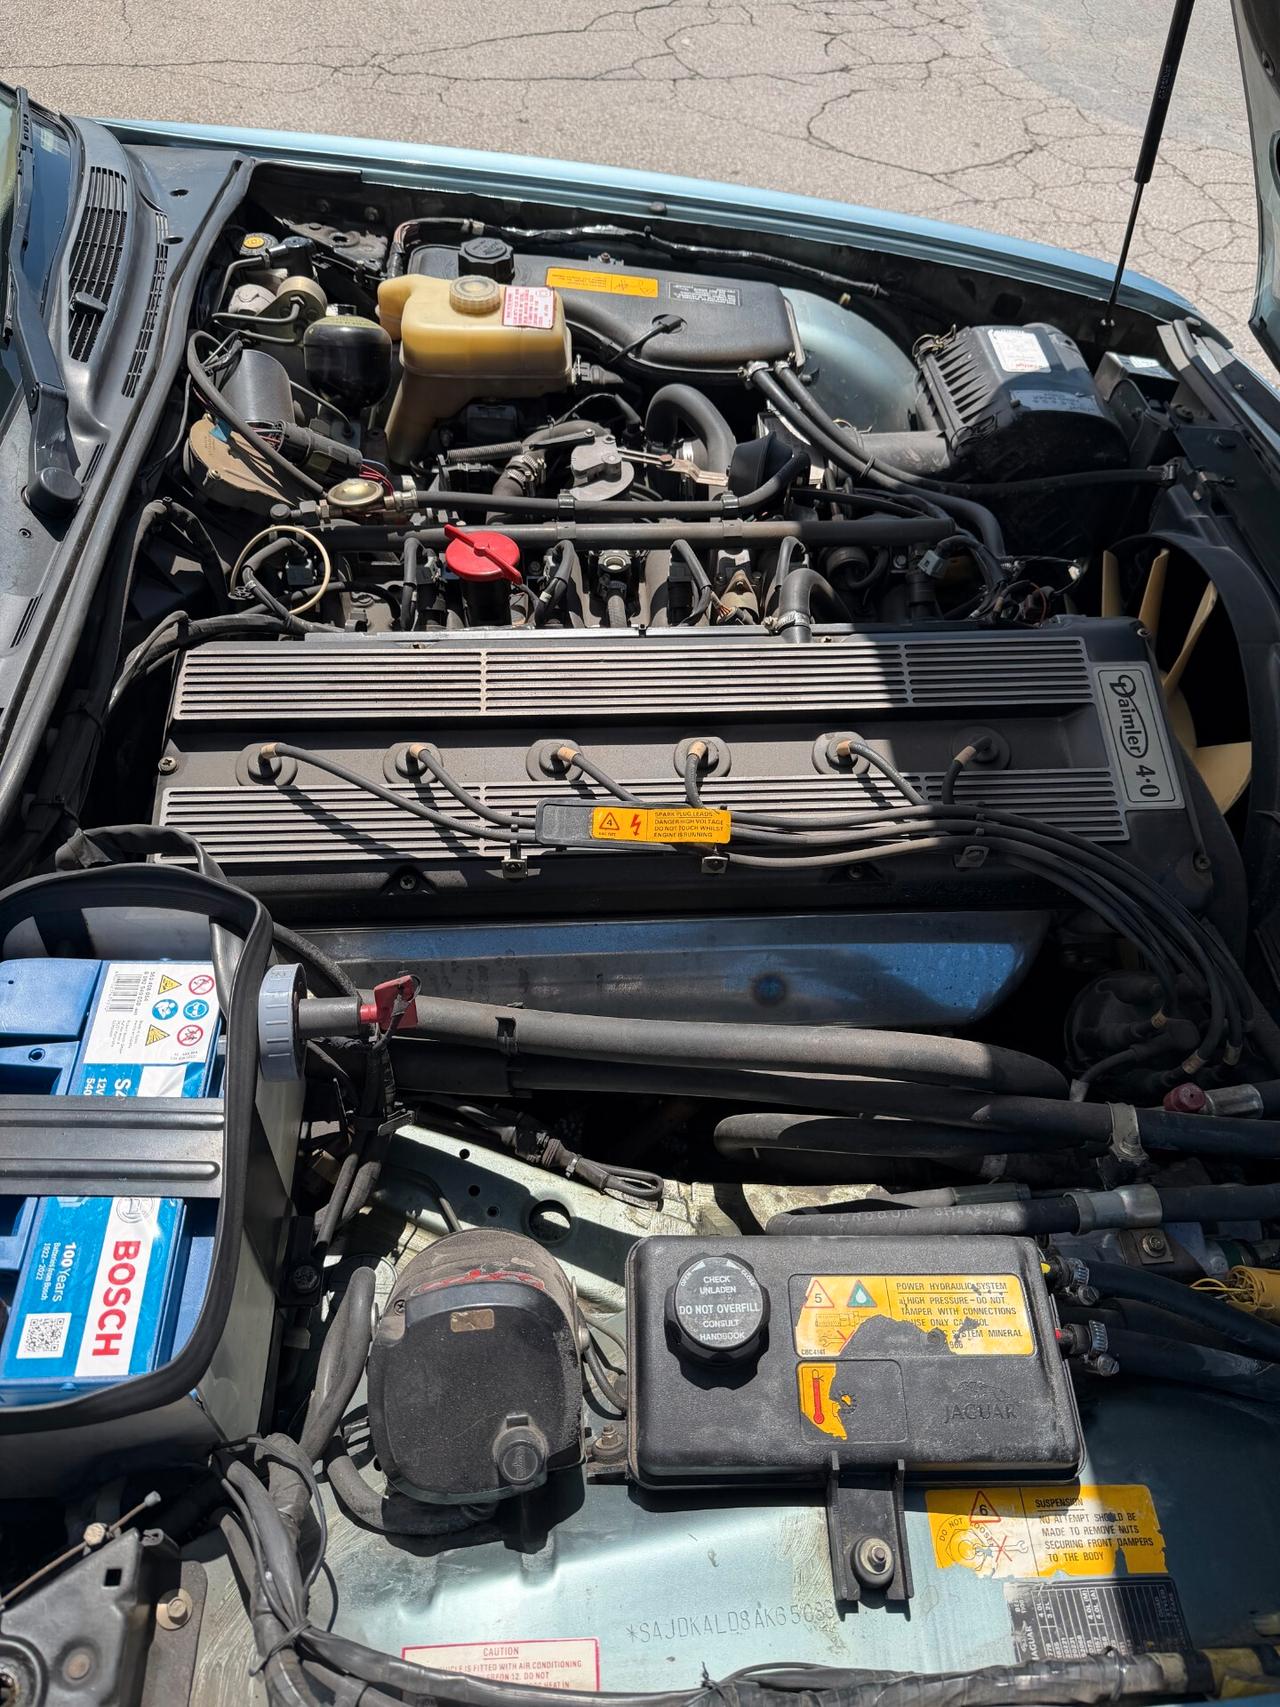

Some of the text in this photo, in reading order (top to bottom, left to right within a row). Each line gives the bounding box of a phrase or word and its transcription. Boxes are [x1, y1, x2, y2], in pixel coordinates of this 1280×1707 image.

[1109, 674, 1148, 758] Daimler
[84, 1077, 95, 1096] 540
[96, 1077, 107, 1096] 12V
[41, 1242, 61, 1301] Batteries from Bosch
[681, 1269, 757, 1289] OPEN CLOSE
[703, 1275, 731, 1284] CHECK
[699, 1286, 736, 1295] UNLADEN
[896, 1282, 1007, 1290] POWER HYDRAULIC SYSTEM
[92, 1240, 141, 1356] BOSCH
[814, 1293, 822, 1303] 5
[930, 1296, 968, 1304] PRESSURE
[976, 1296, 987, 1304] DO
[990, 1296, 1005, 1304] NOT
[679, 1302, 760, 1315] DO NOT OVERFILL
[936, 1307, 959, 1315] WITH
[963, 1307, 1017, 1315] CONNECTIONS
[702, 1319, 740, 1328] CONSULT
[930, 1318, 949, 1326] ONLY
[699, 1331, 745, 1340] HANDBOOK
[952, 1329, 984, 1338] SSTEM
[988, 1329, 1023, 1338] MINERAL
[943, 1403, 1018, 1424] JAGUAR
[1035, 1498, 1083, 1508] SUSPENSION
[980, 1504, 988, 1516] 6
[1040, 1515, 1050, 1524] NO
[1054, 1513, 1090, 1524] ATTEMPT
[1127, 1512, 1137, 1521] BE
[939, 1529, 948, 1542] DO
[948, 1517, 963, 1529] NOT
[1041, 1525, 1140, 1536] MADE TO REMOVE NUTS
[1044, 1537, 1154, 1550] SECURING FRONT DAMPERS
[1048, 1551, 1104, 1562] TO THE BODY
[483, 1646, 519, 1657] CAUTION
[464, 1664, 471, 1672] IS
[532, 1660, 582, 1669] CONDITIONING
[524, 1672, 533, 1680] DO
[536, 1671, 549, 1679] NOT
